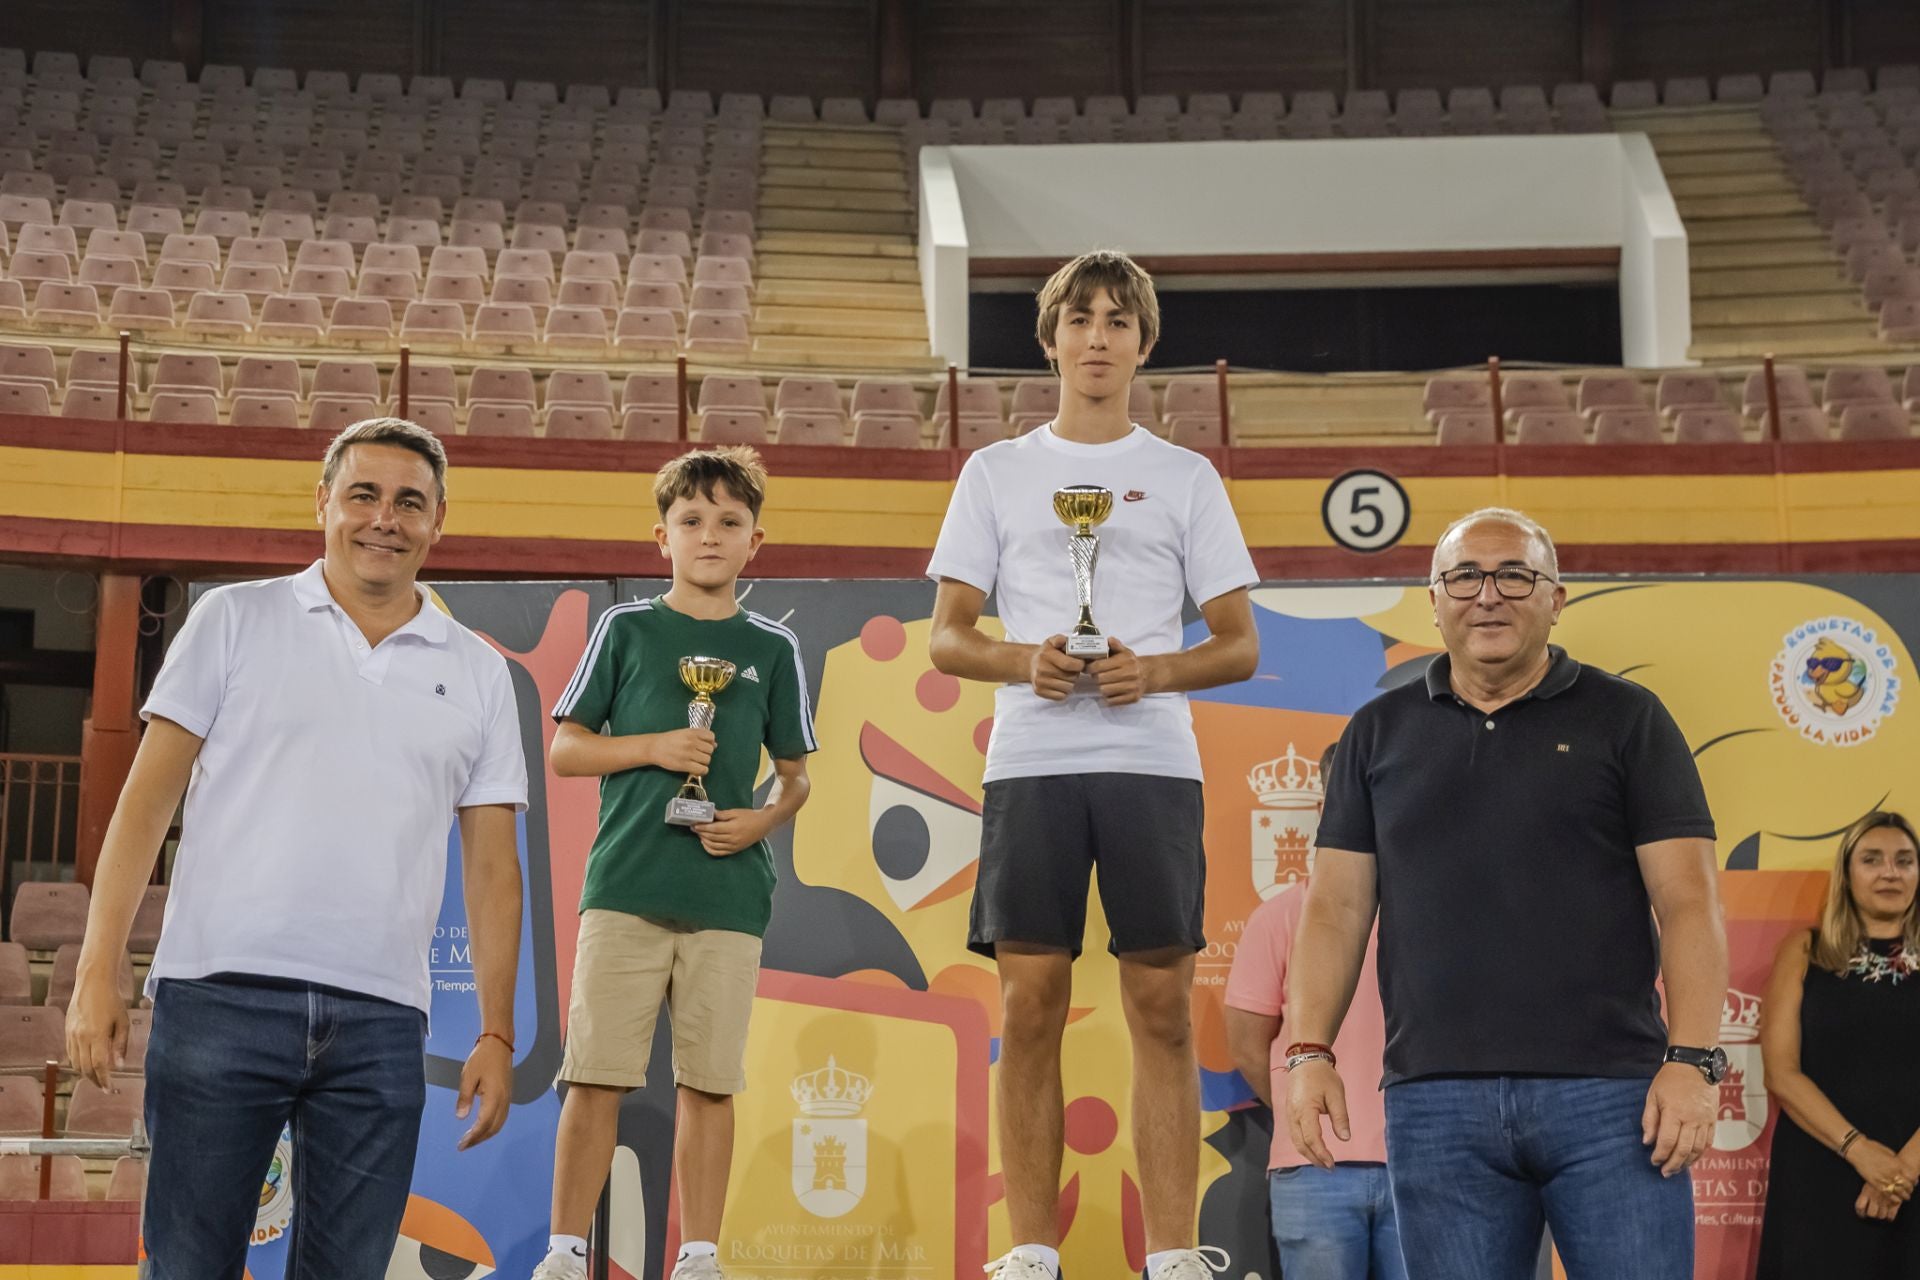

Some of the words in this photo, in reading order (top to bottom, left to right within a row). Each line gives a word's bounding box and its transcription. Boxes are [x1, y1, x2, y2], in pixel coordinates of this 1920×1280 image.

[1350, 487, 1384, 538] 5
[1786, 619, 1873, 648] ROQUETAS
[1876, 647, 1894, 668] DE
[1880, 677, 1897, 714] MAR
[1803, 724, 1824, 742] LA
[1834, 724, 1872, 744] VIDA
[449, 926, 467, 939] DE
[430, 947, 440, 964] E
[435, 980, 477, 993] Tiempo
[1193, 975, 1209, 986] rea
[1210, 973, 1226, 986] de
[1692, 1179, 1738, 1197] ETAS
[1747, 1179, 1769, 1197] D
[1695, 1213, 1719, 1226] rtes,
[250, 1224, 280, 1243] IDA
[765, 1224, 874, 1236] AYUNTAMIENTO
[877, 1224, 896, 1236] DE
[730, 1239, 835, 1263] ROQUETAS
[843, 1246, 868, 1261] DE
[877, 1240, 927, 1262] MAR
